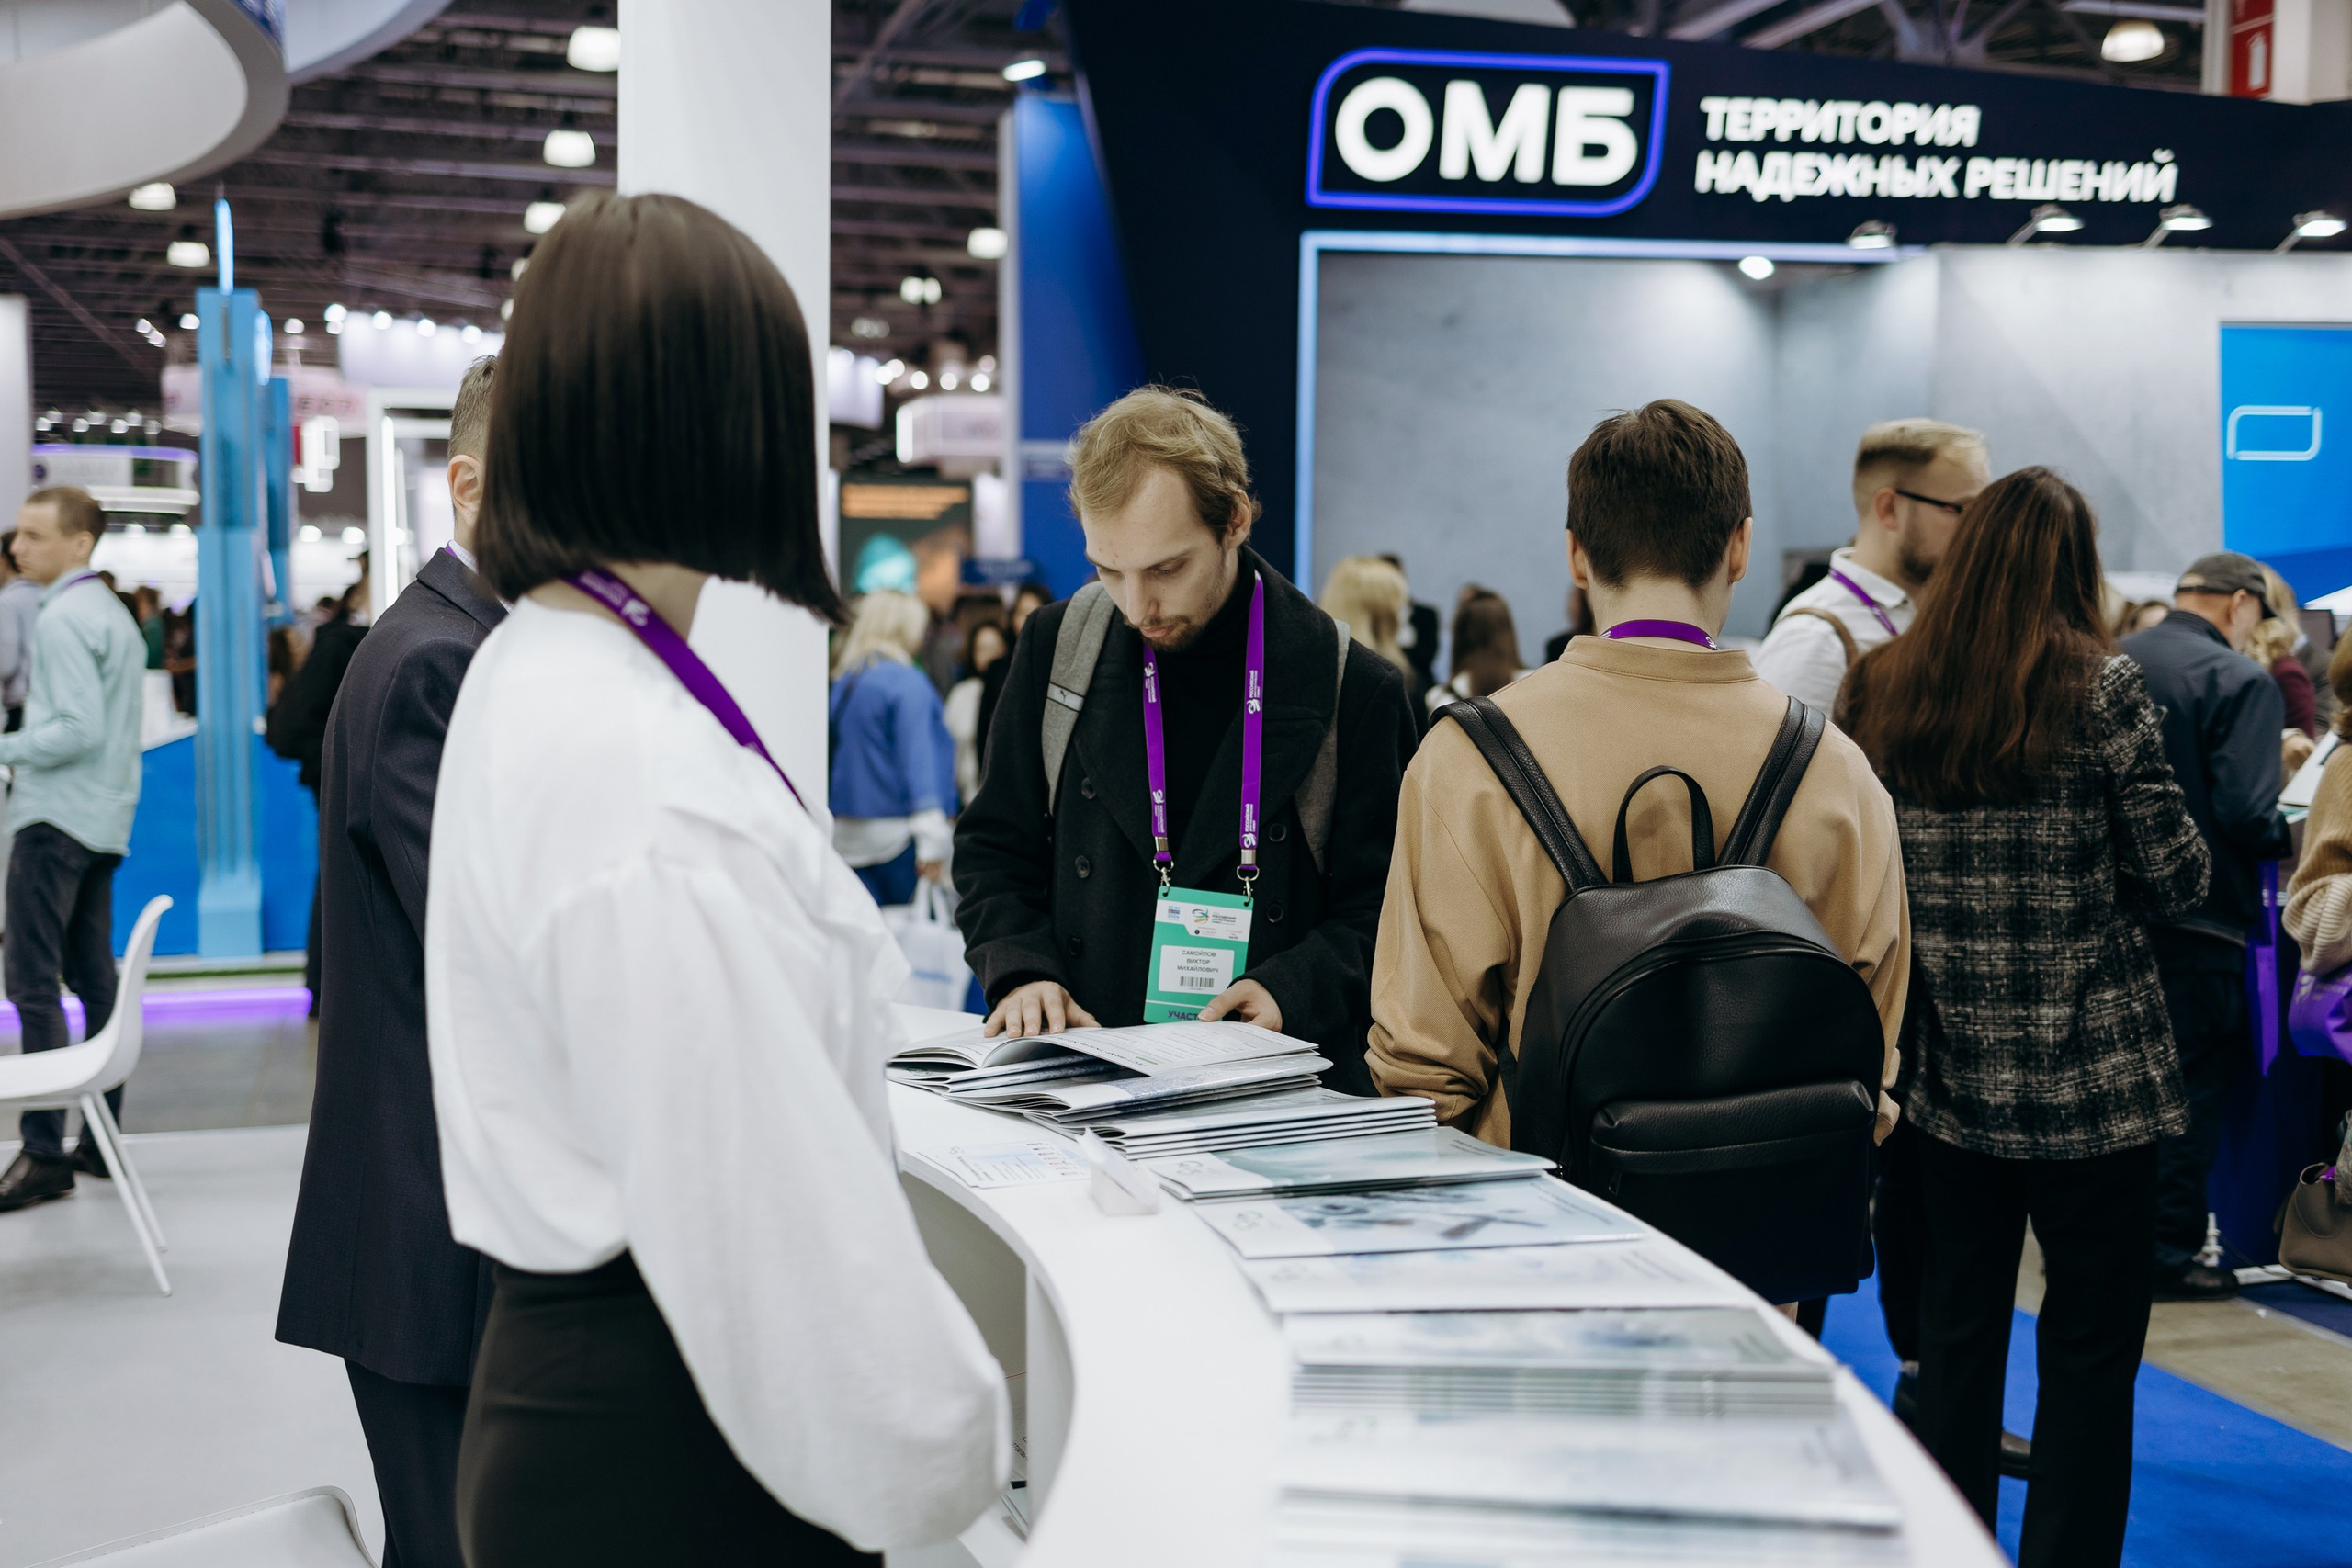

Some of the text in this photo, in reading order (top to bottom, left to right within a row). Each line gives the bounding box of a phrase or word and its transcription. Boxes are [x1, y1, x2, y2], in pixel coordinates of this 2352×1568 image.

[1334, 77, 1639, 186] ОМБ
[1700, 96, 1982, 148] ТЕРРИТОРИЯ
[1695, 148, 2179, 203] НАДЕЖНЫХ РЕШЕНИЙ
[1182, 949, 1216, 957] САМОЙЛОВ
[1168, 1010, 1201, 1021] УЧАСТ
